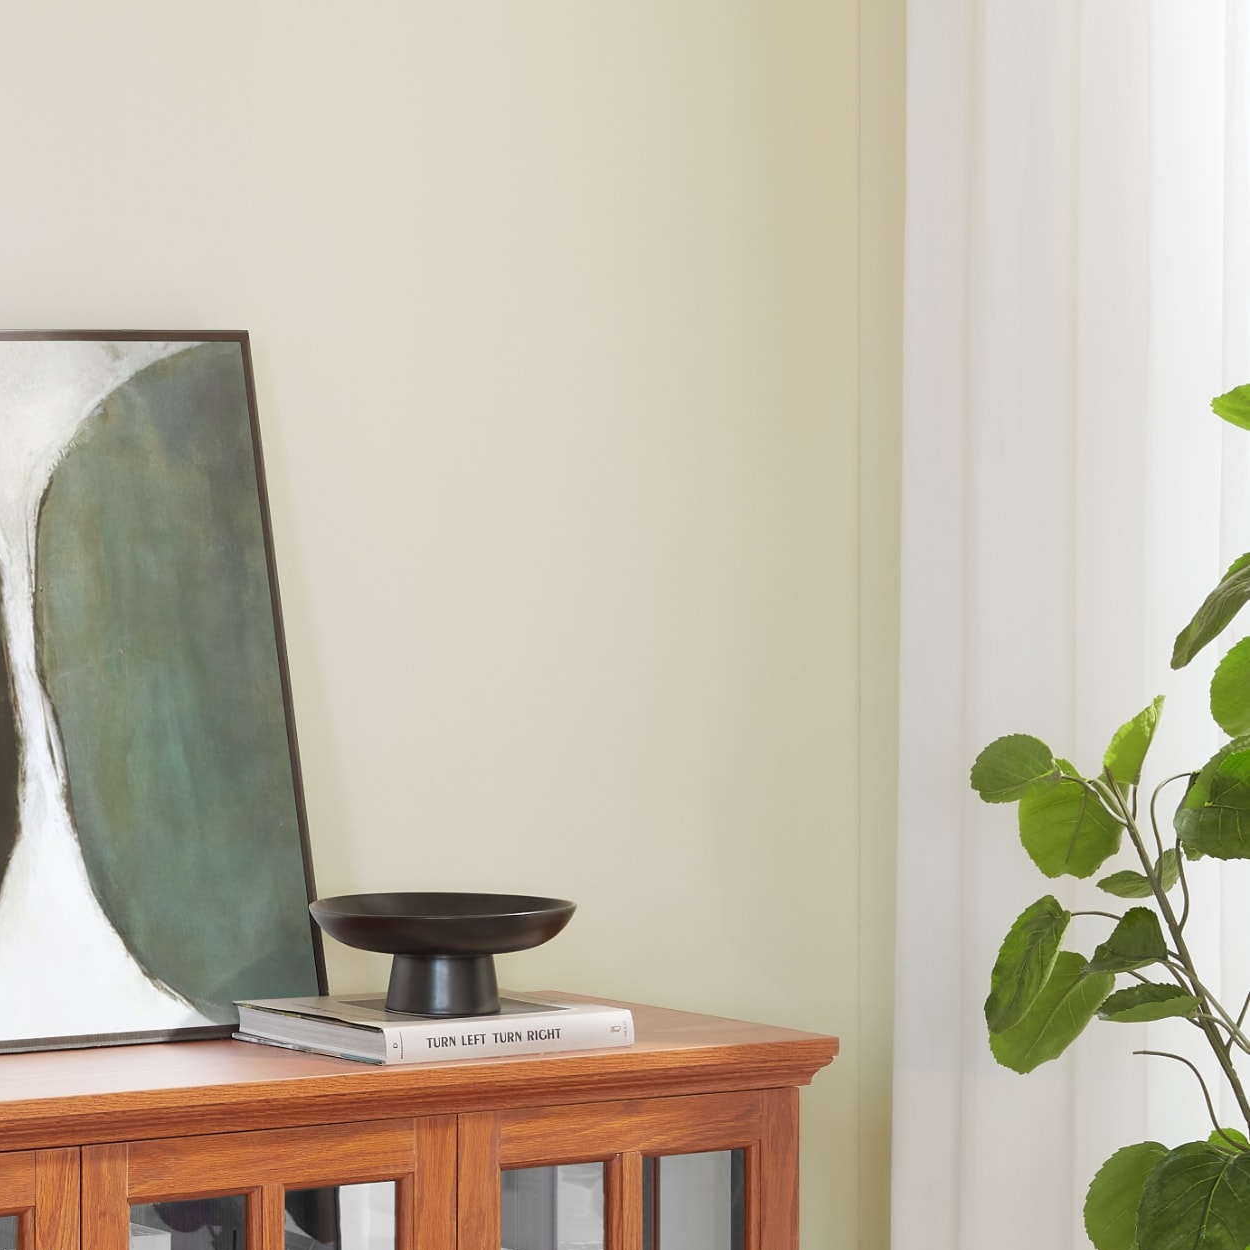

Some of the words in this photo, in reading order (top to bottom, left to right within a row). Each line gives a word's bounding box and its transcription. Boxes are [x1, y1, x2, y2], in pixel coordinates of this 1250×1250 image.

[426, 1036, 456, 1048] TURN
[461, 1034, 487, 1046] LEFT
[492, 1031, 522, 1044] TURN
[527, 1028, 562, 1042] RIGHT
